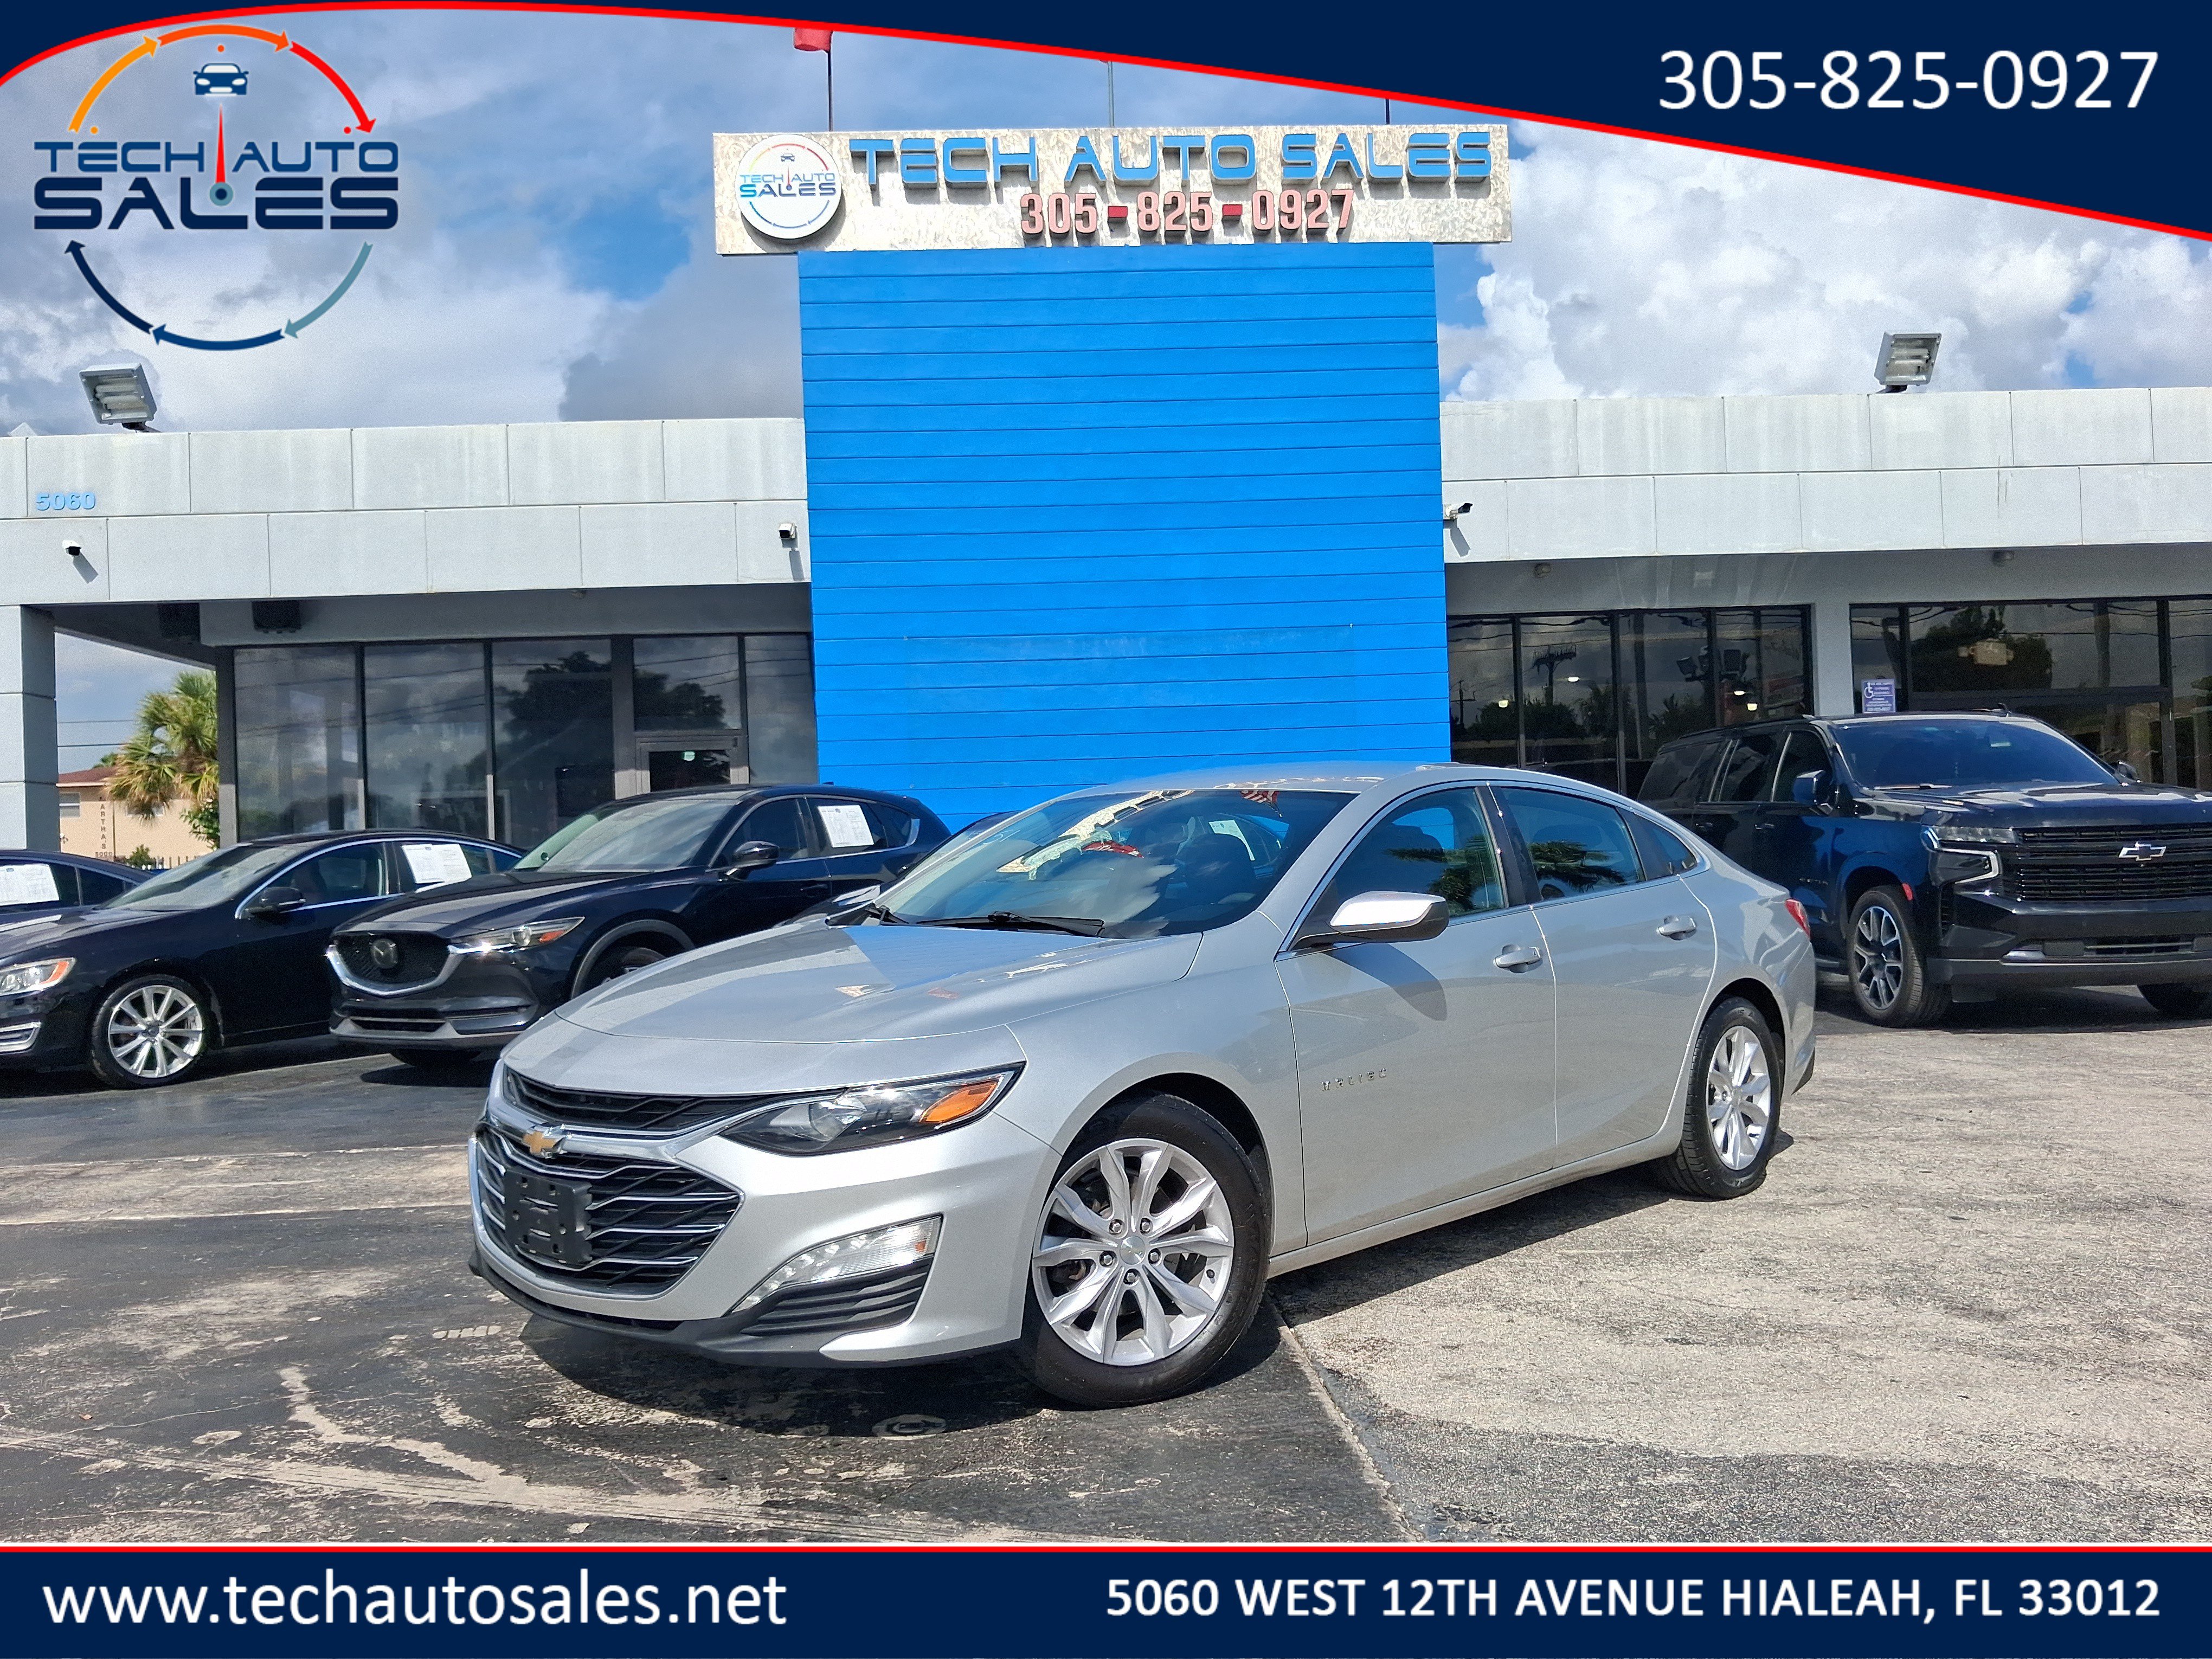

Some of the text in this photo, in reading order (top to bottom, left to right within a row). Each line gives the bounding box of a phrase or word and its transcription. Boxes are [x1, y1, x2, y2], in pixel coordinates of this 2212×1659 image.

[849, 132, 1491, 186] TECH AUTO SALES
[740, 172, 835, 183] TECH AUTO
[739, 182, 837, 198] SALES
[1020, 189, 1355, 234] 305-825-0927
[36, 492, 96, 511] 5060
[1321, 1068, 1387, 1091] MALIBU
